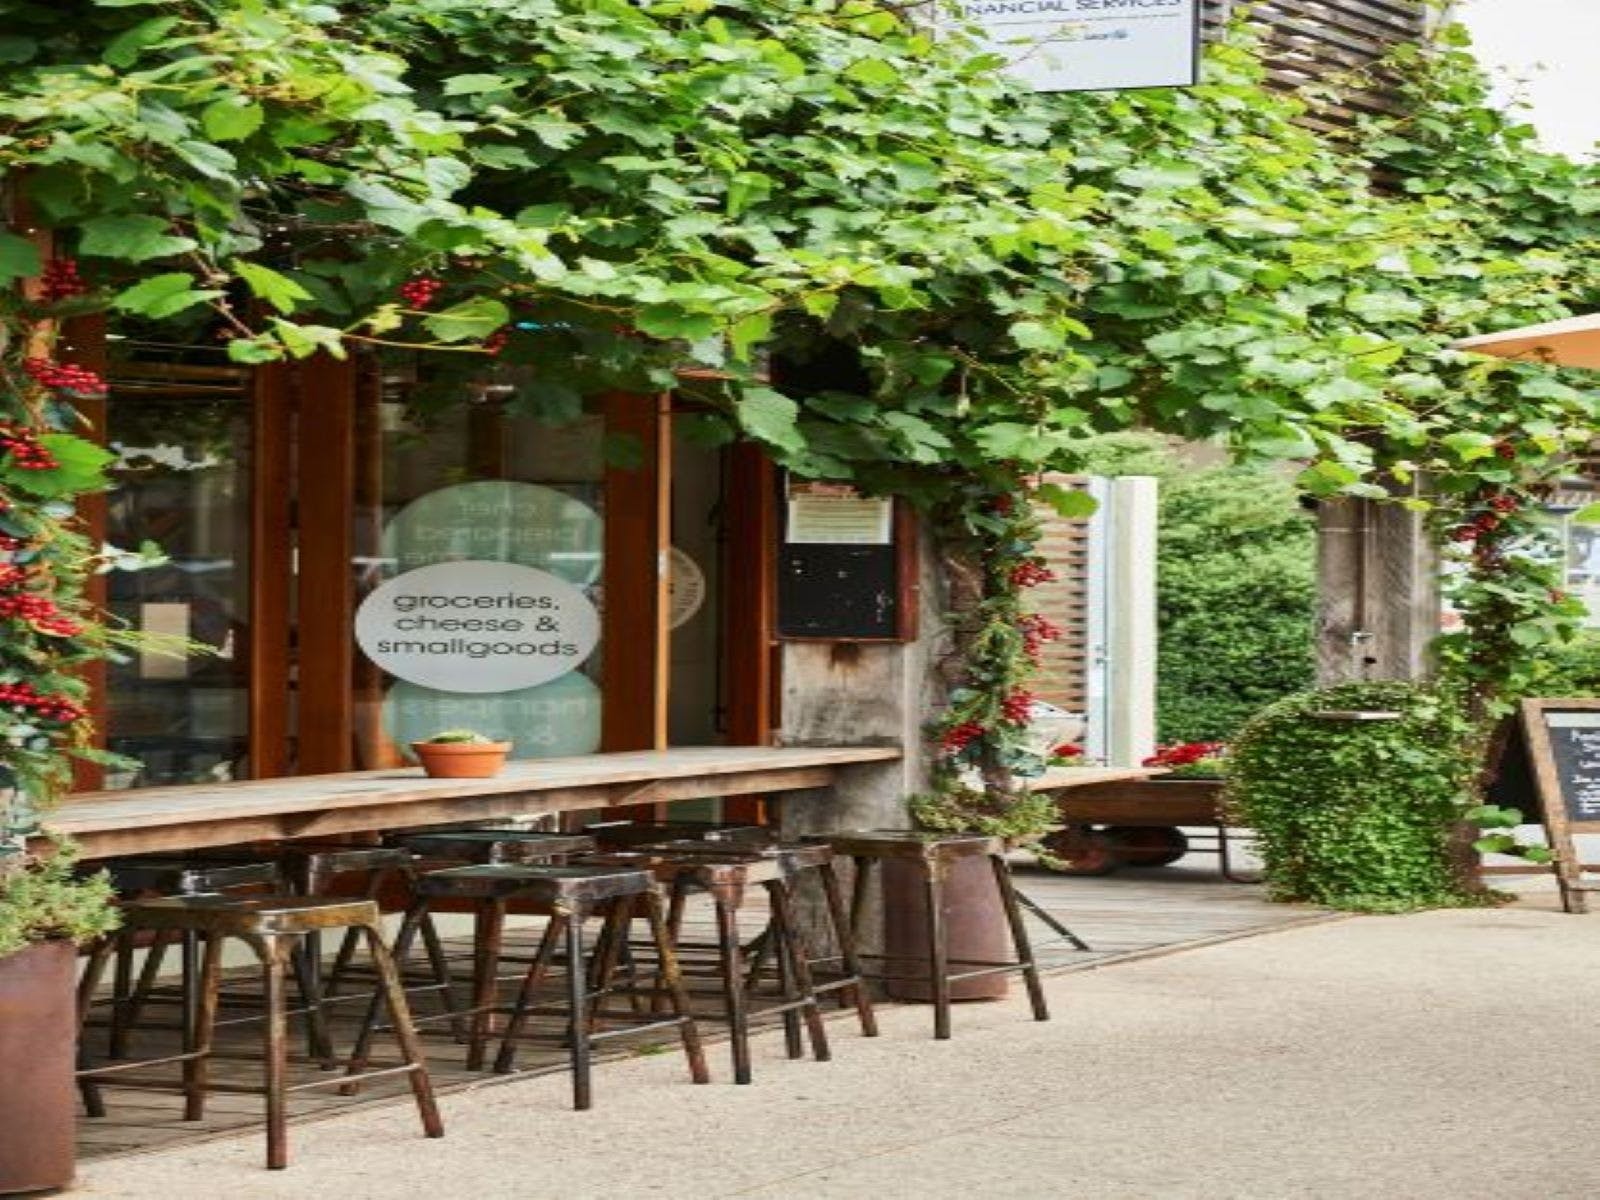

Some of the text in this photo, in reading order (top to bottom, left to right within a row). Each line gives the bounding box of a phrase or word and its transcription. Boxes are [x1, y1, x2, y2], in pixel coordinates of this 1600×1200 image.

[393, 592, 560, 612] groceries,
[395, 615, 559, 632] cheese &
[376, 638, 579, 659] smallgoods
